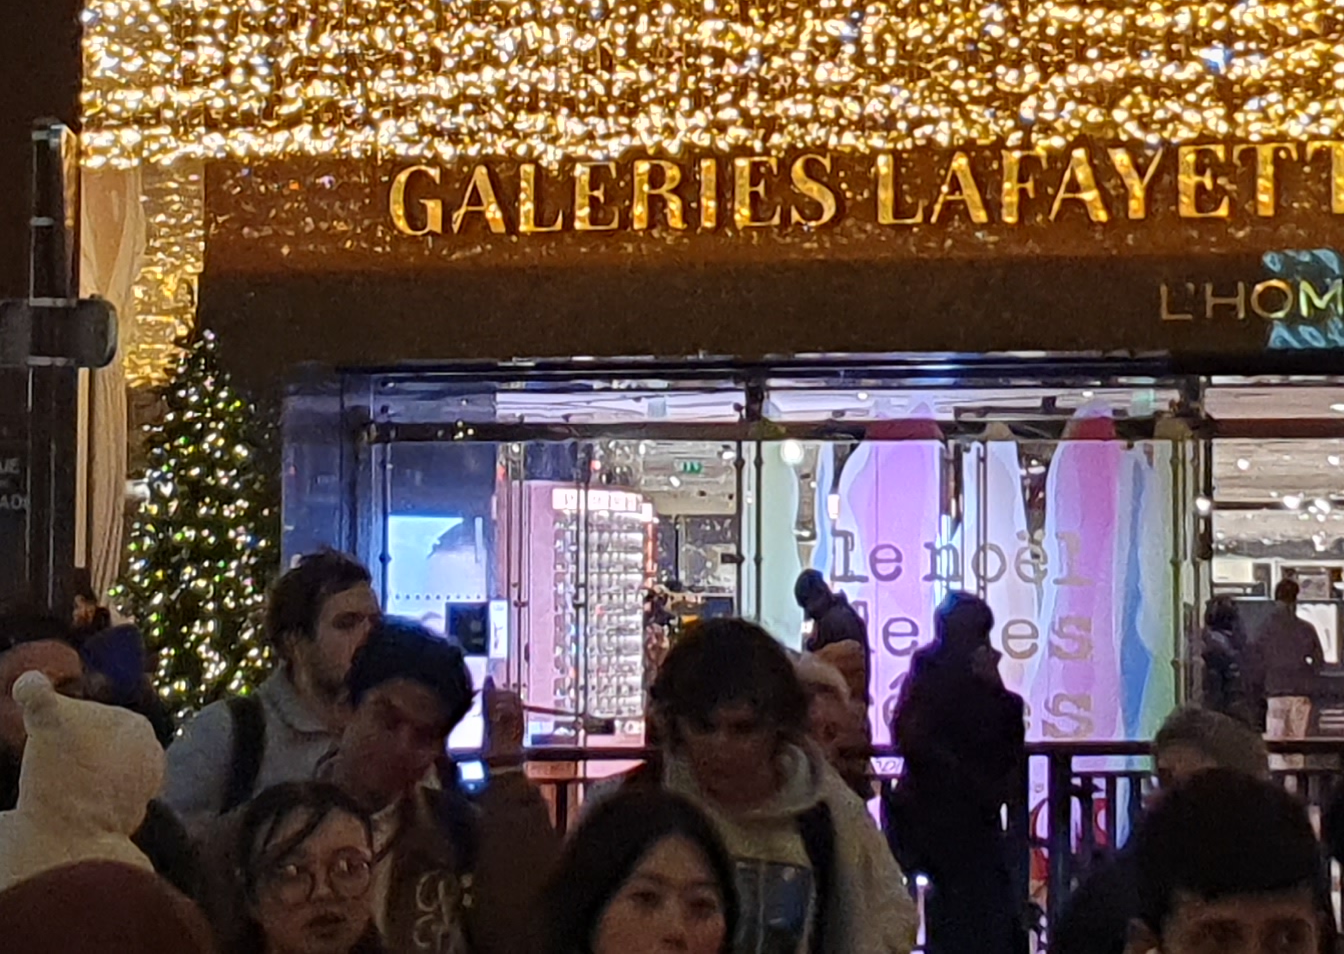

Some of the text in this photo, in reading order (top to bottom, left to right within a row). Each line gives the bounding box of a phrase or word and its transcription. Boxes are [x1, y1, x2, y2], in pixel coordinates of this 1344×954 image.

[390, 153, 838, 235] GALERIES
[830, 529, 1092, 585] le noël
